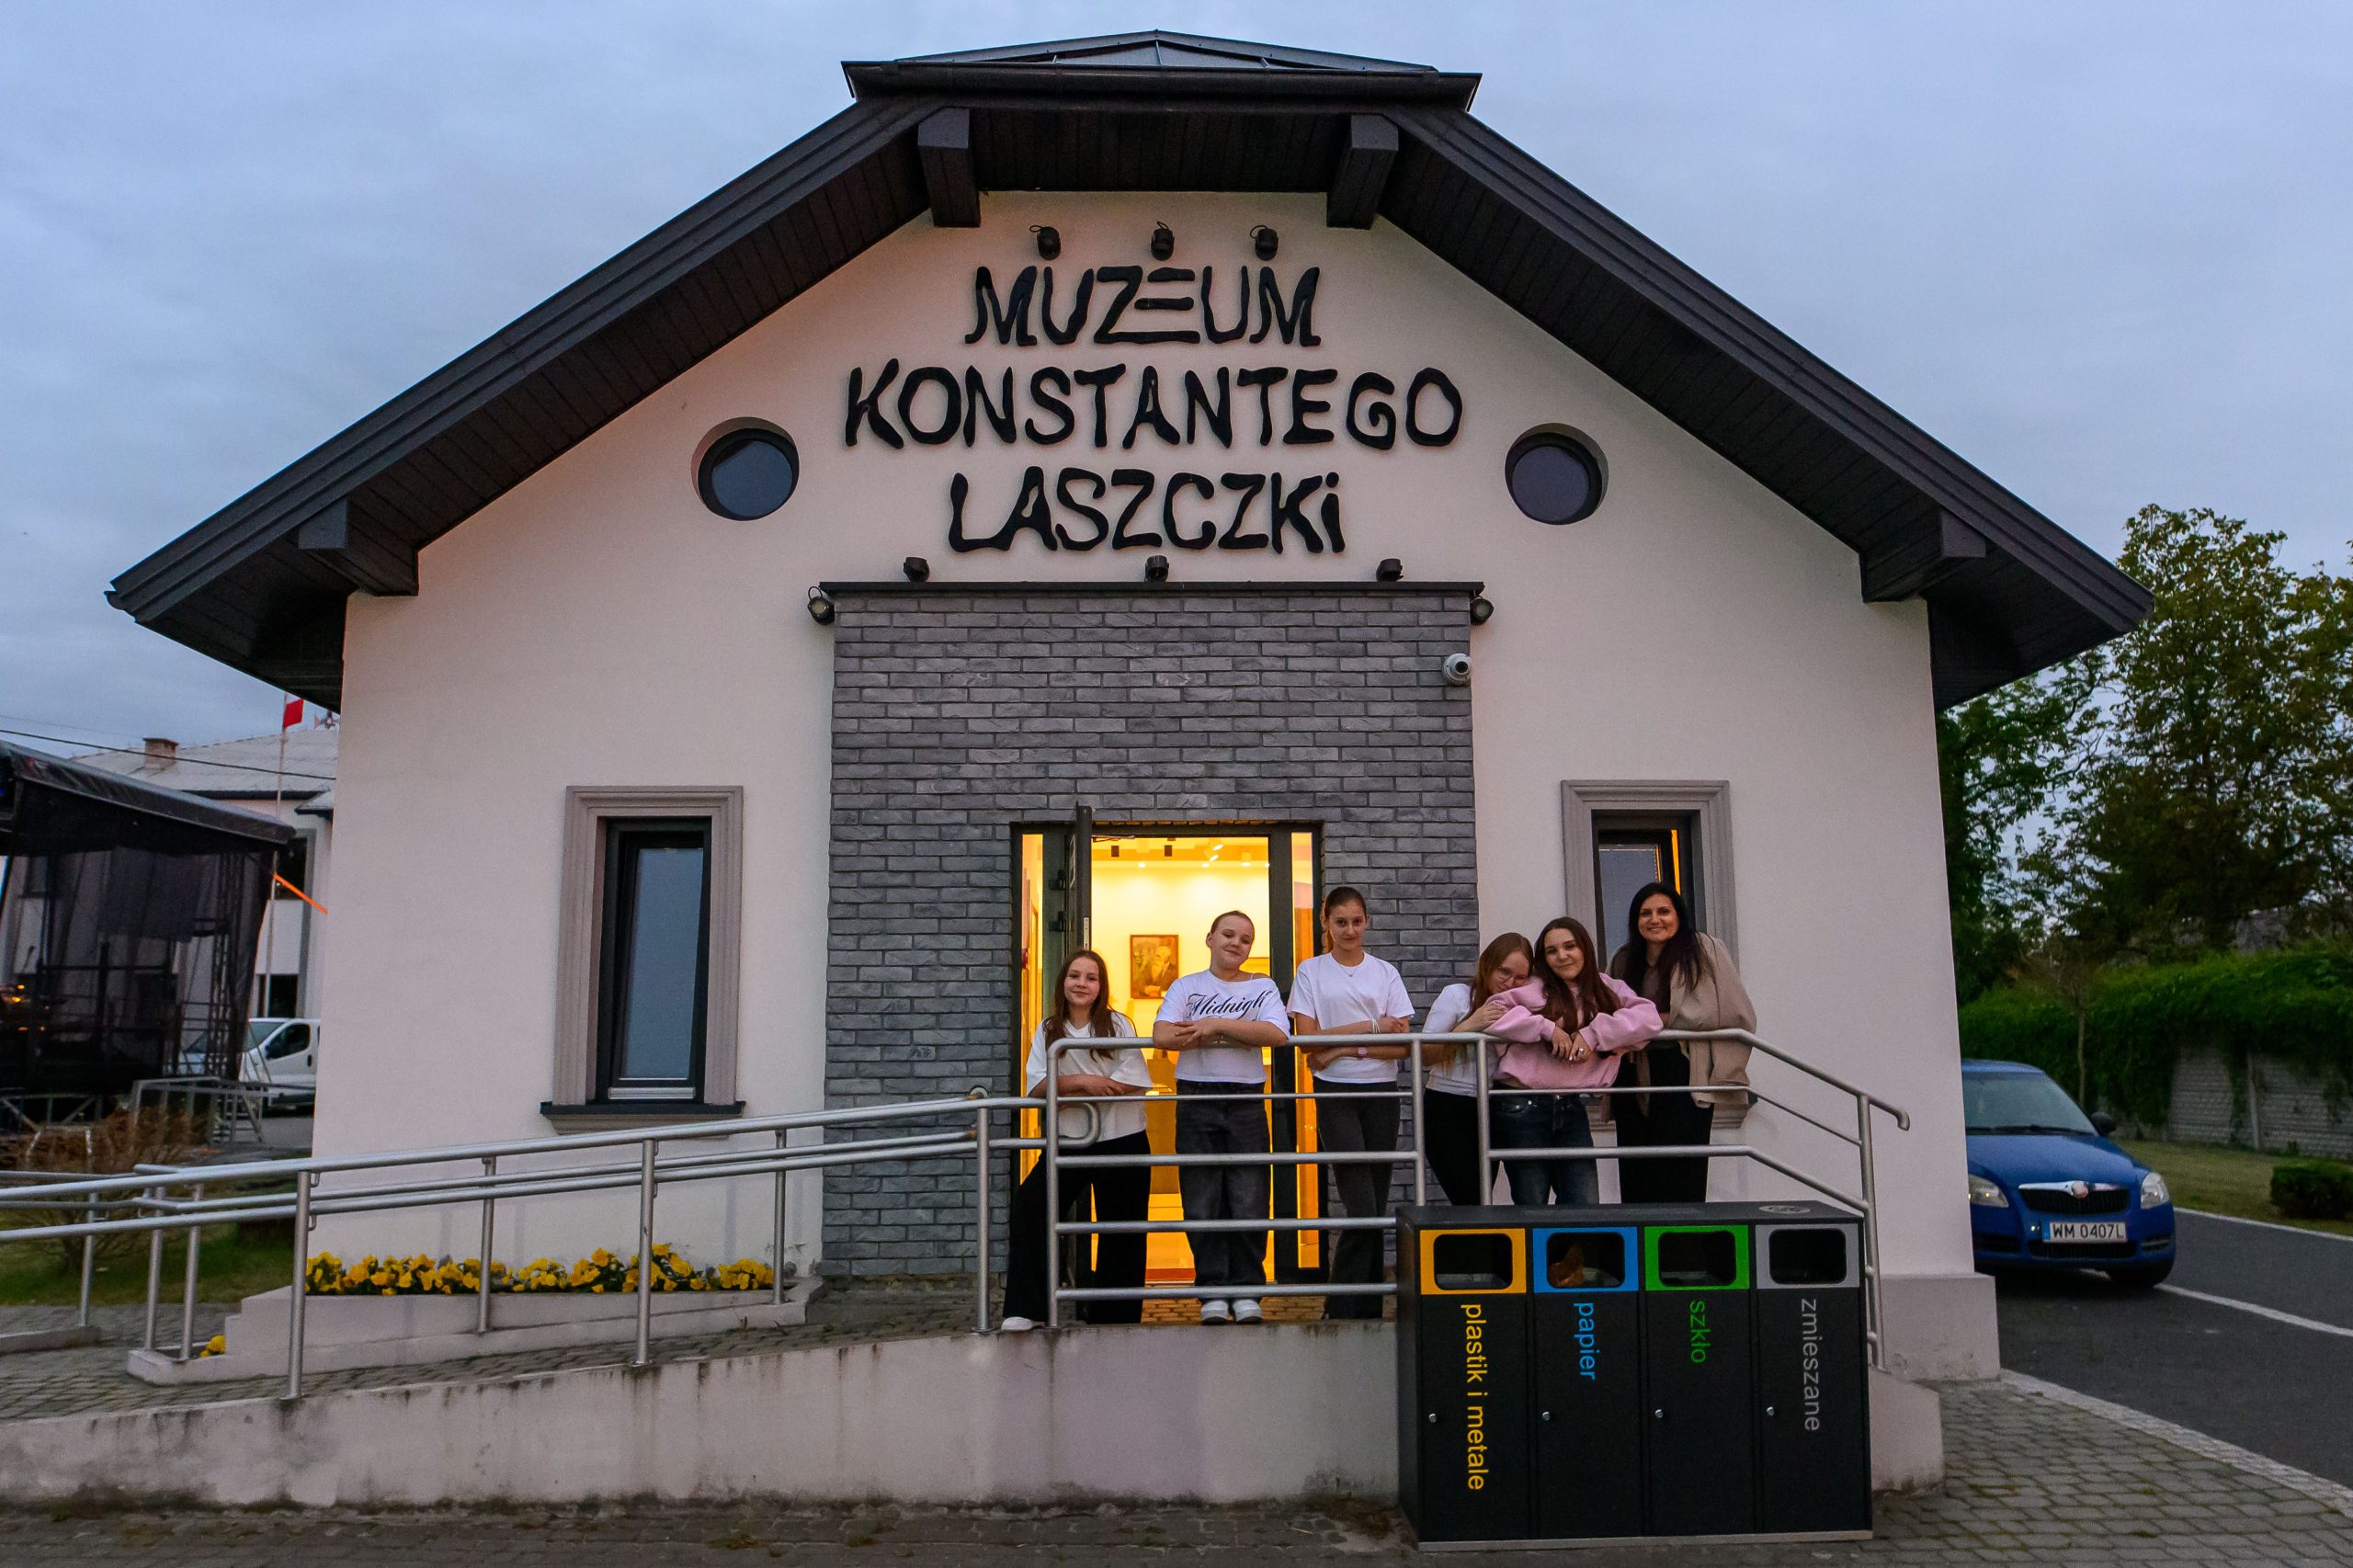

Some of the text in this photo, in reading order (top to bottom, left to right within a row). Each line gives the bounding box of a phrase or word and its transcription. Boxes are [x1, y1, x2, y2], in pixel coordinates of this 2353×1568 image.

[965, 265, 1322, 347] MUZEUM
[845, 358, 1463, 450] KONSTANTEGO
[1186, 989, 1273, 1020] Midnigh
[2052, 1223, 2125, 1239] WM 0407L
[1461, 1303, 1488, 1383] plastik
[1573, 1302, 1600, 1381] papier
[1801, 1298, 1823, 1431] zmieszane
[1467, 1405, 1489, 1491] metale
